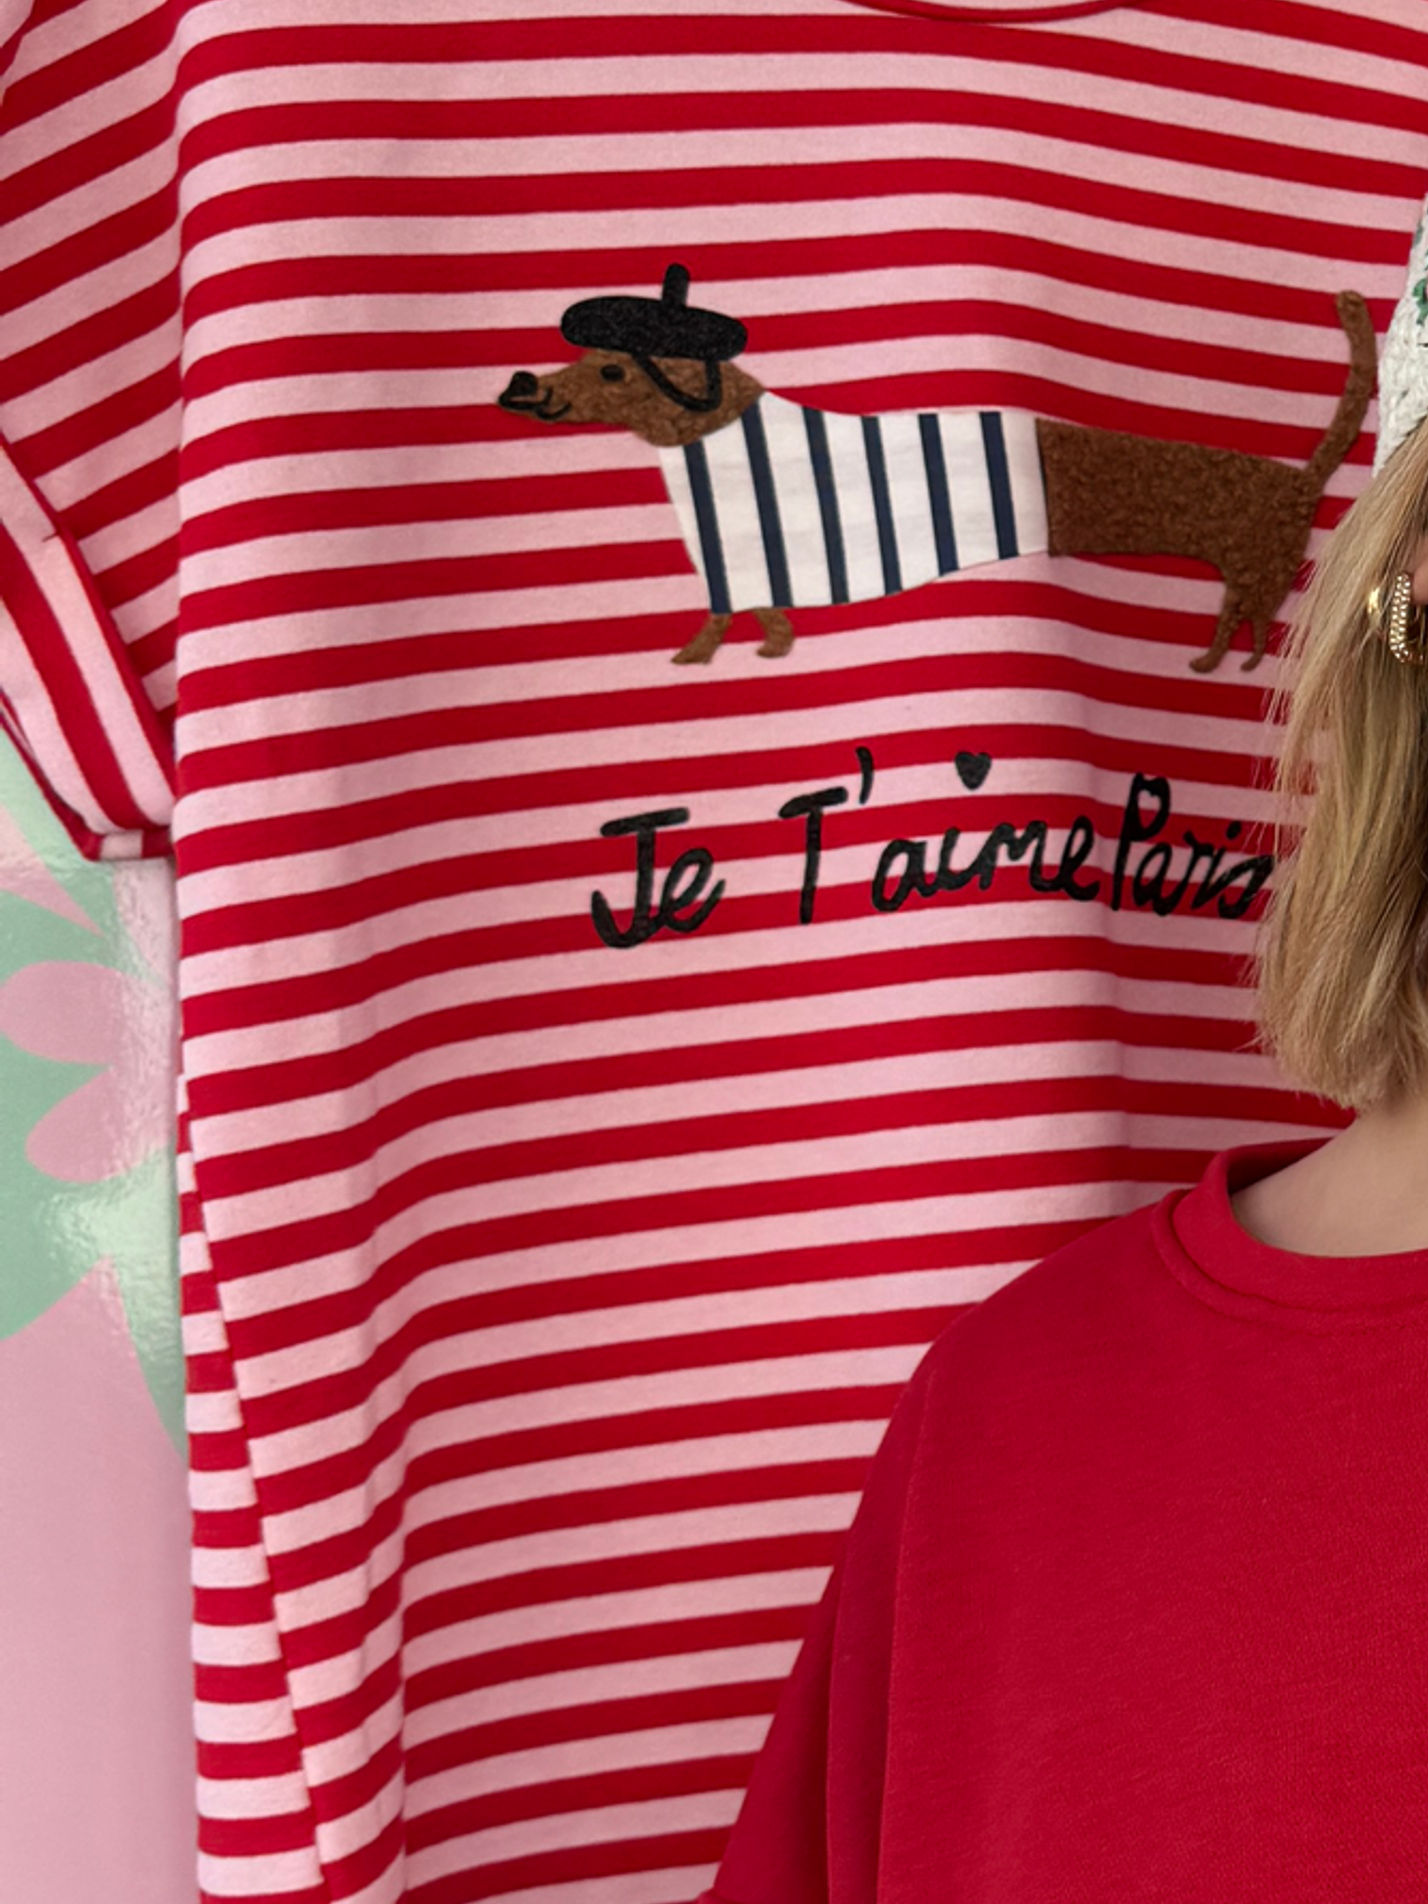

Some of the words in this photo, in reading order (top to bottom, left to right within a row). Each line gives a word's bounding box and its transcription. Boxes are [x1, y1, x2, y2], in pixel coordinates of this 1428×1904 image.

[591, 806, 726, 949] Je
[777, 746, 1103, 925] T'aime
[1110, 772, 1275, 919] Paris
